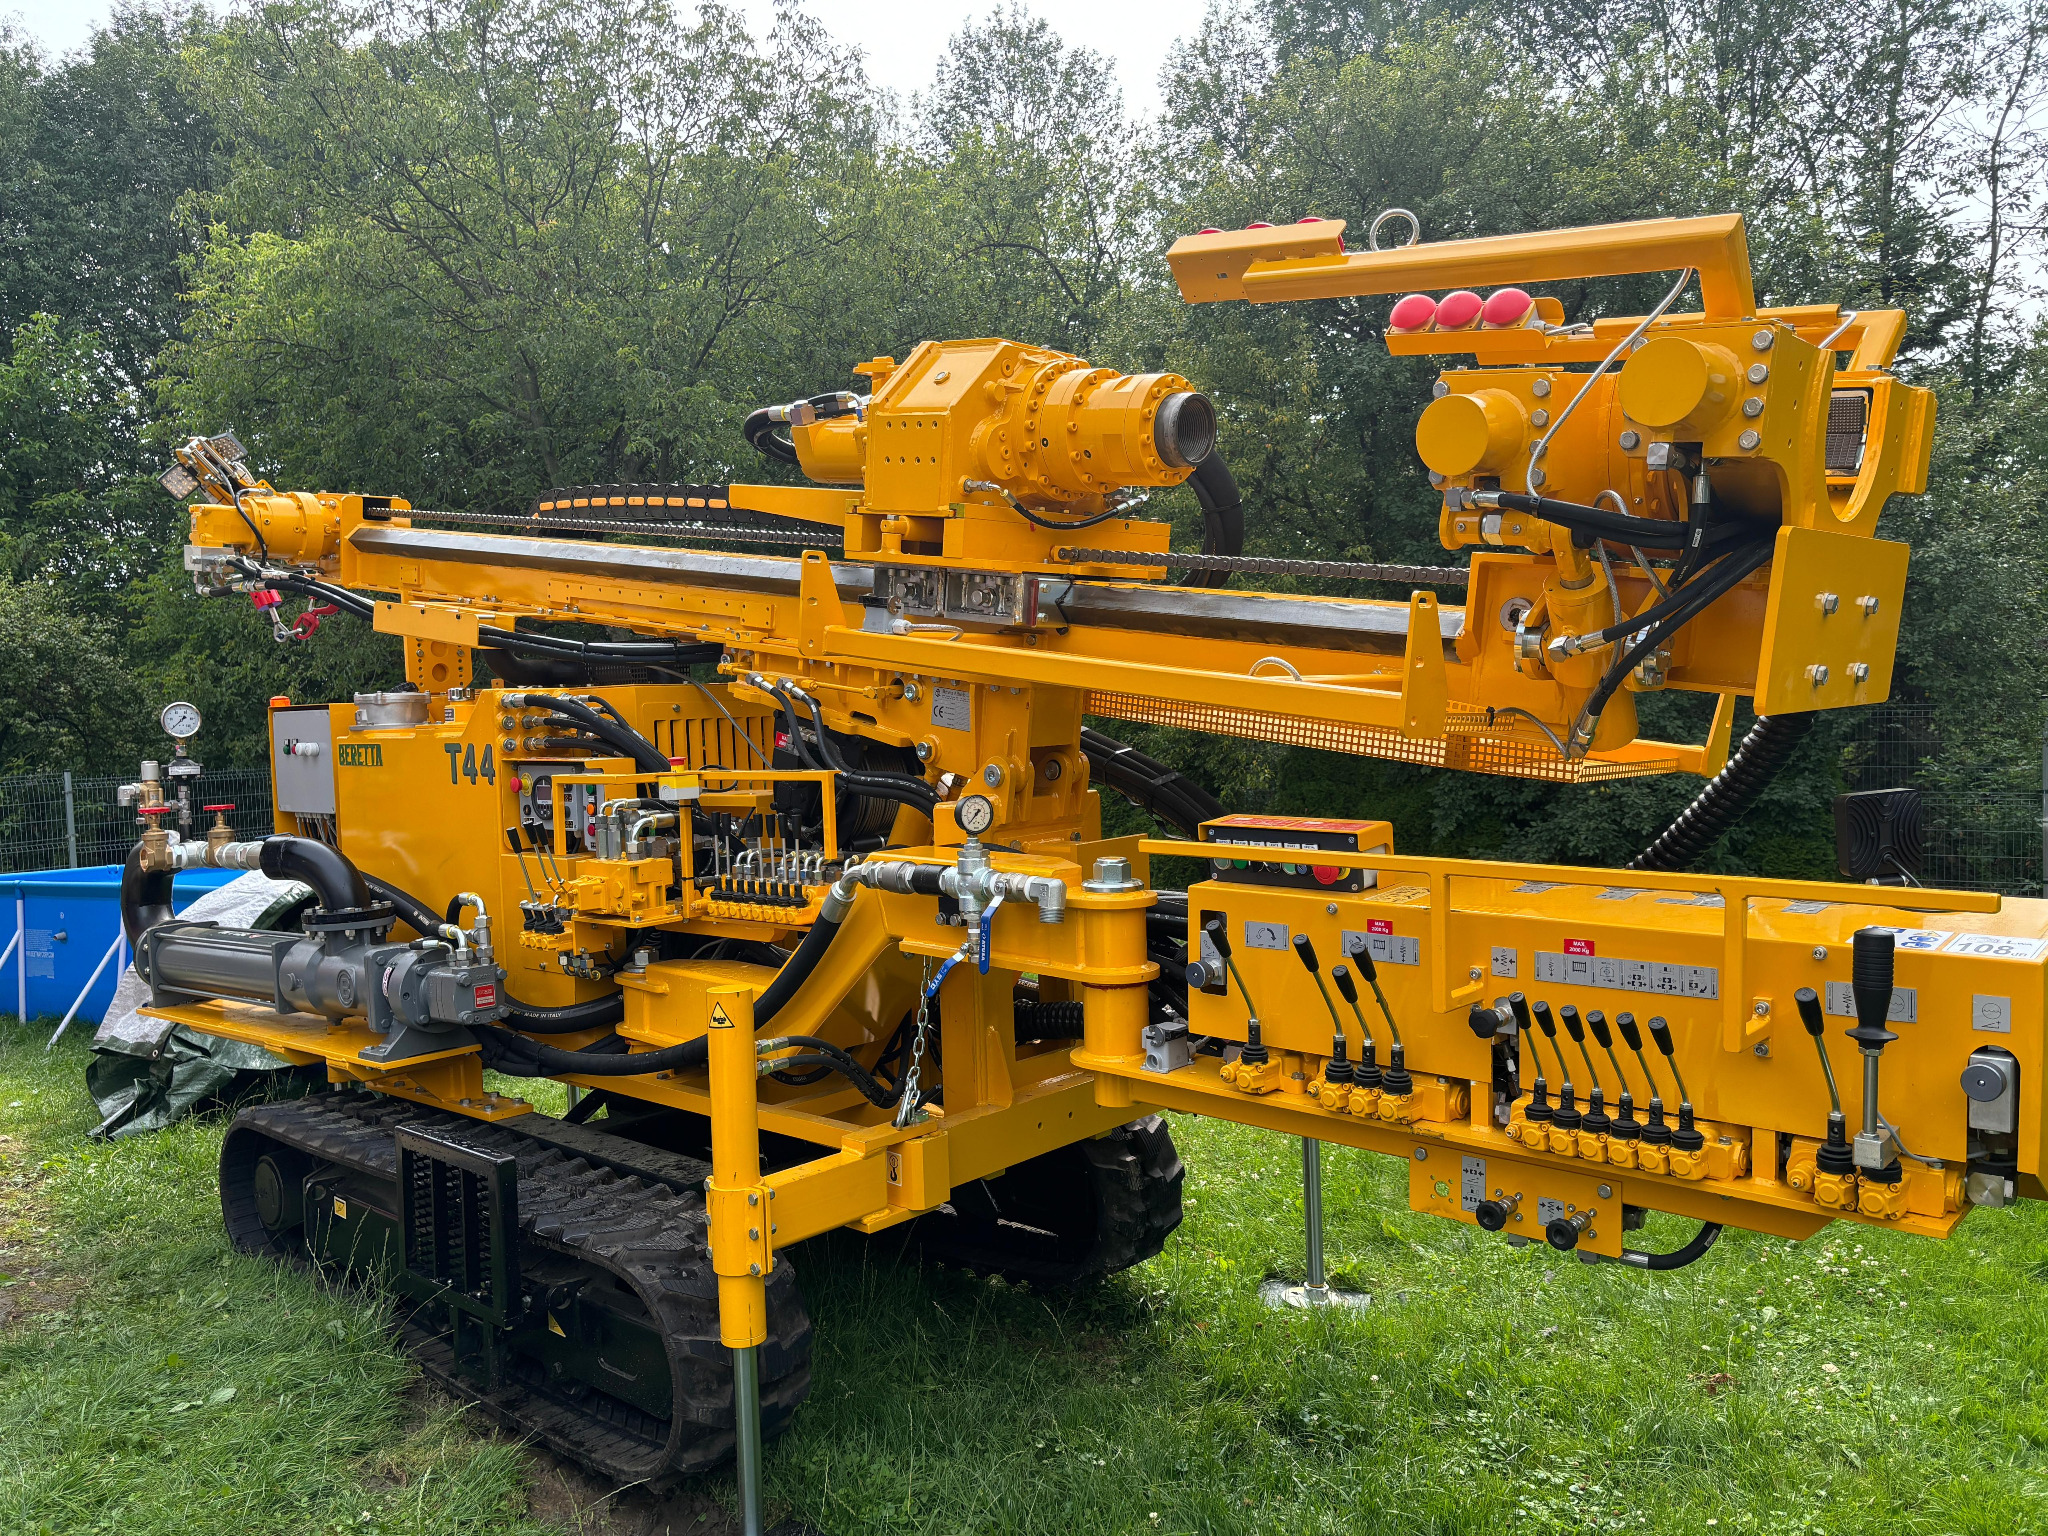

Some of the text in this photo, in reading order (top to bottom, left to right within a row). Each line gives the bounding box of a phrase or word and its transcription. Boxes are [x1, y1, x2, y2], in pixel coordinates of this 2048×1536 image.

[338, 744, 383, 766] BERETTA
[444, 743, 496, 786] T44
[1957, 942, 2014, 955] 108
